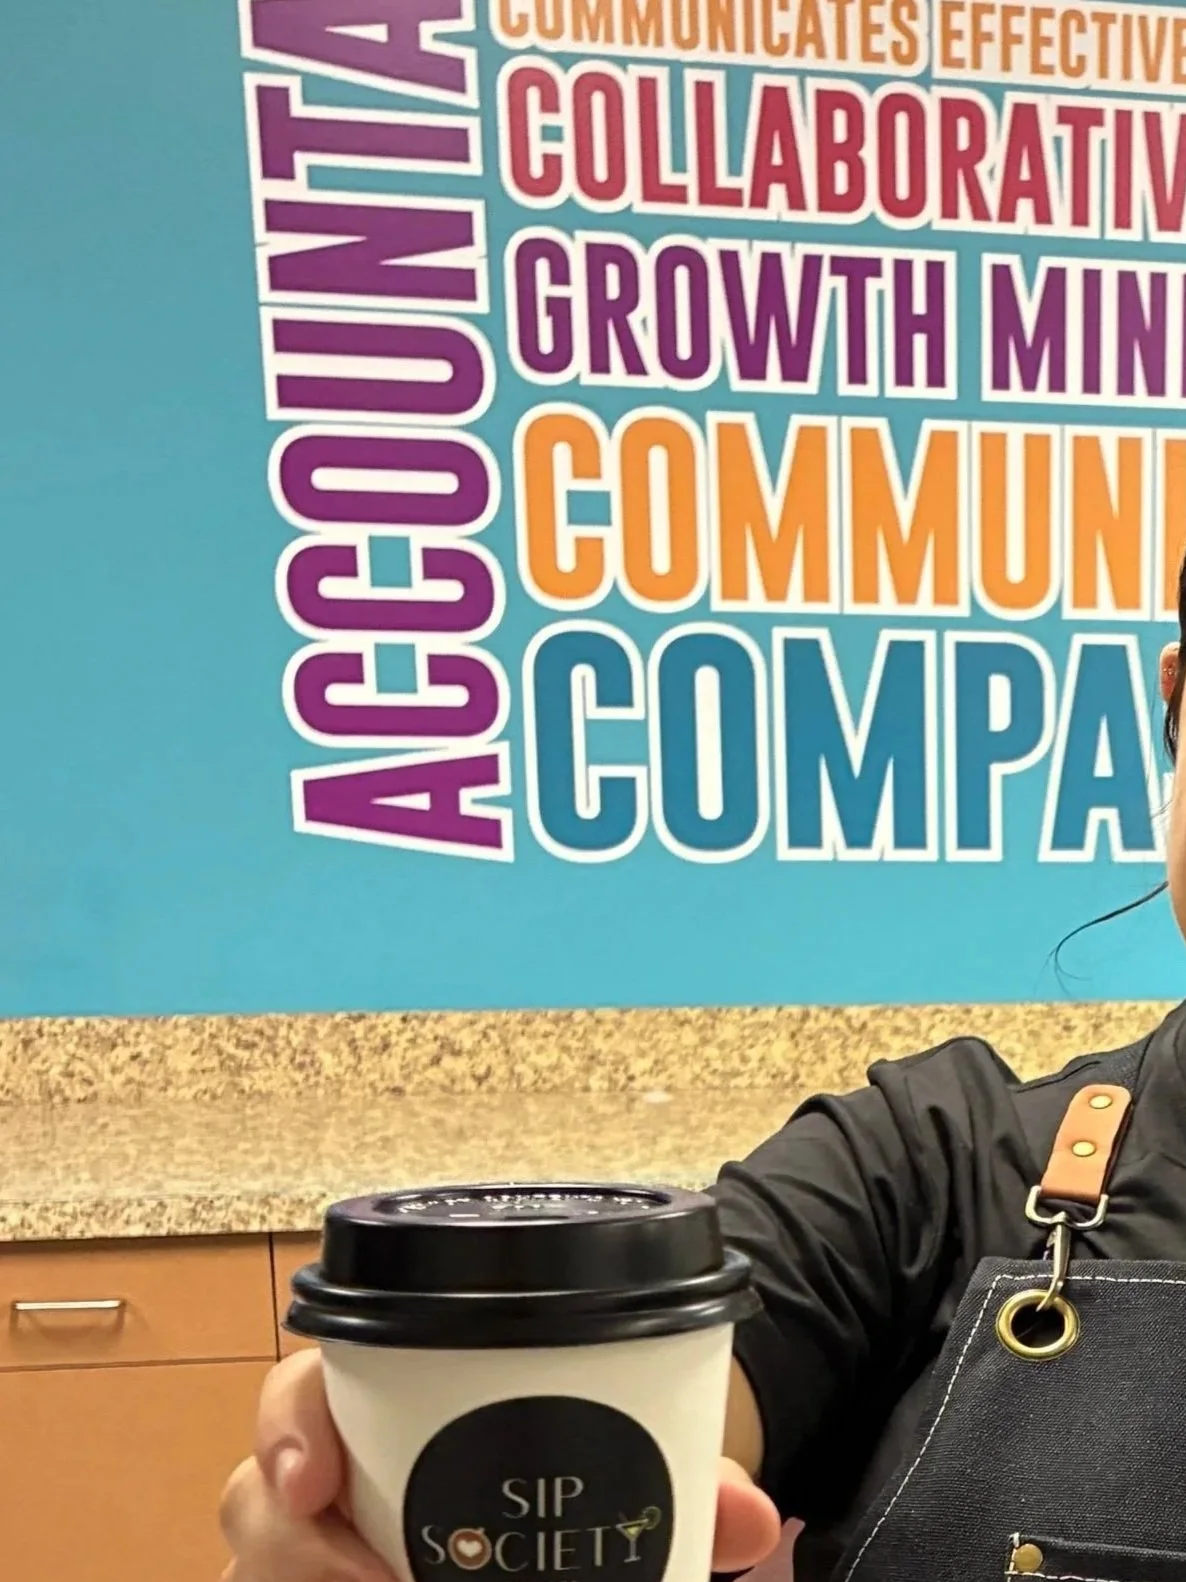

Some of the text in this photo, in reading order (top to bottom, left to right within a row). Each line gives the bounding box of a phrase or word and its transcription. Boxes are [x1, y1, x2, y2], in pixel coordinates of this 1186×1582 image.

[499, 0, 918, 63] COMMUNICATES
[513, 237, 948, 390] GROWTH
[501, 1476, 584, 1519] SIP
[421, 1506, 662, 1572] SOCIETY
